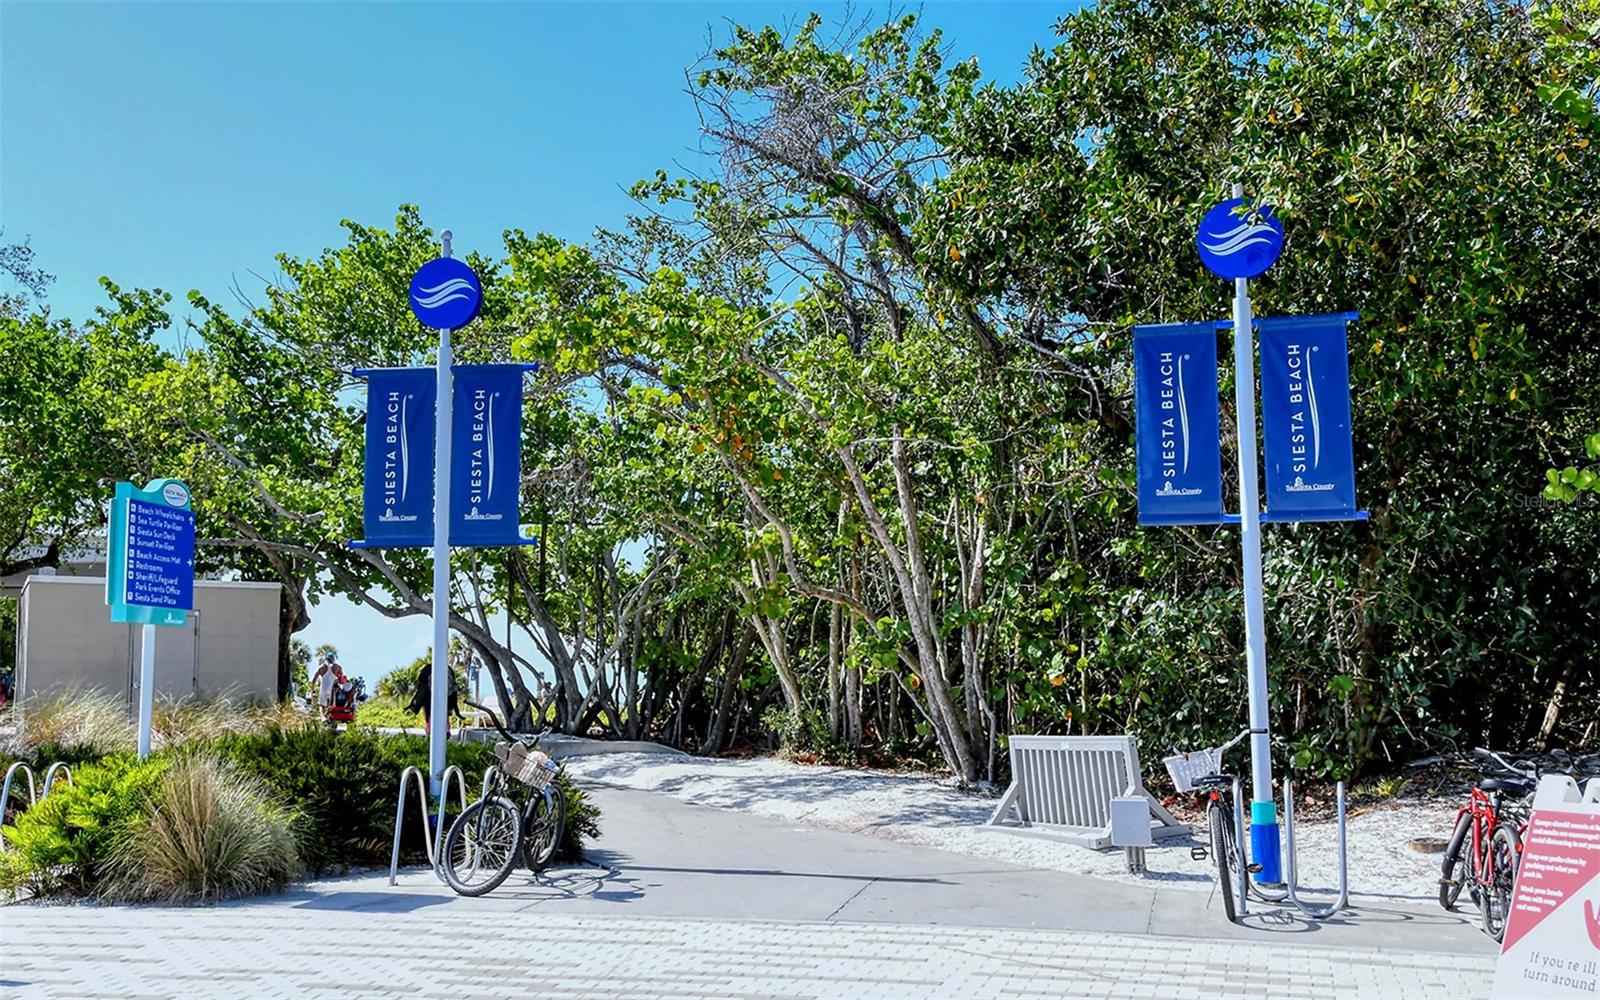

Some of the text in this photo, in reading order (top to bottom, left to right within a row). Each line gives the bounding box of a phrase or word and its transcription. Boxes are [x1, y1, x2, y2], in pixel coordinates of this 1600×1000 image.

[1160, 352, 1176, 477] SIESTA BEACH
[1288, 344, 1306, 473] SIESTA BEACH
[385, 391, 400, 505] SIESTA BEACH
[470, 389, 486, 504] SIESTA BEACH
[138, 504, 185, 521] Beach Wheelchairs
[137, 515, 183, 531] Sea Turtle Pavilion
[137, 526, 176, 540] Siesta Sun Deck
[137, 537, 175, 551] Sunset Pavilion
[136, 550, 181, 564] Beach Access Mat
[136, 560, 164, 572] Restrooms
[135, 582, 181, 595] Park Events Office
[134, 592, 150, 601] Siesta
[163, 595, 177, 605] Plaza
[1530, 951, 1540, 964] If
[1524, 968, 1548, 982] turn
